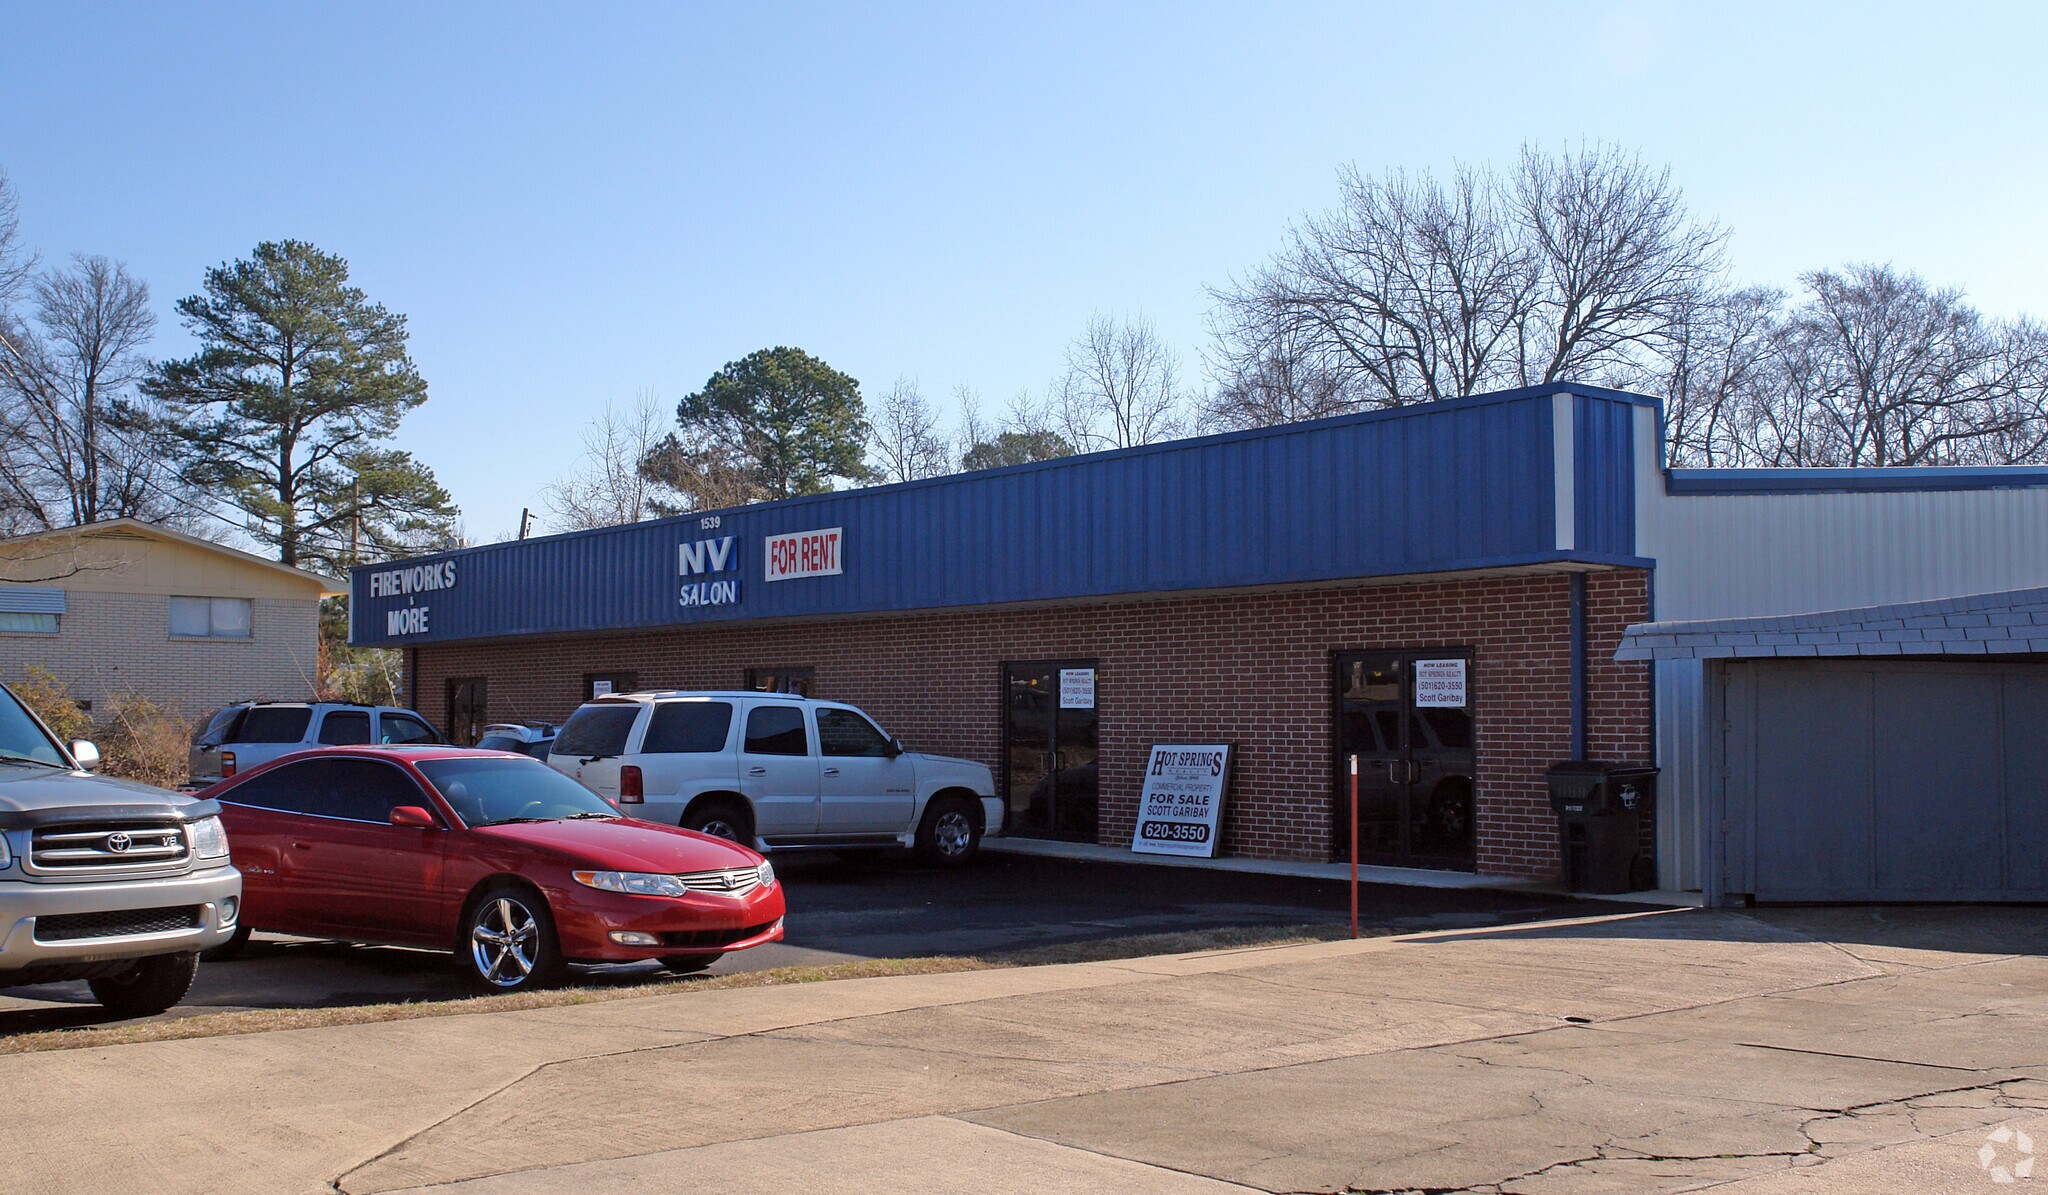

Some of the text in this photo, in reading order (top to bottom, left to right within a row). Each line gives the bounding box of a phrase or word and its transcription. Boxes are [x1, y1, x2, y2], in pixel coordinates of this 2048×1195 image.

[700, 516, 721, 530] 1539
[679, 536, 733, 575] NV
[771, 533, 838, 575] FOR RENT
[370, 560, 456, 598] FIREWORKS
[679, 580, 736, 607] SALON
[387, 606, 430, 636] MORE
[1419, 692, 1463, 704] Scott Garibay
[1151, 751, 1222, 776] HOT SPRINGS
[1151, 782, 1213, 793] COMMERCIAL PROPERTY
[1149, 794, 1210, 805] FOR SALE
[1147, 805, 1210, 818] SCOTT GARIBAY
[1145, 824, 1205, 840] 620-3550
